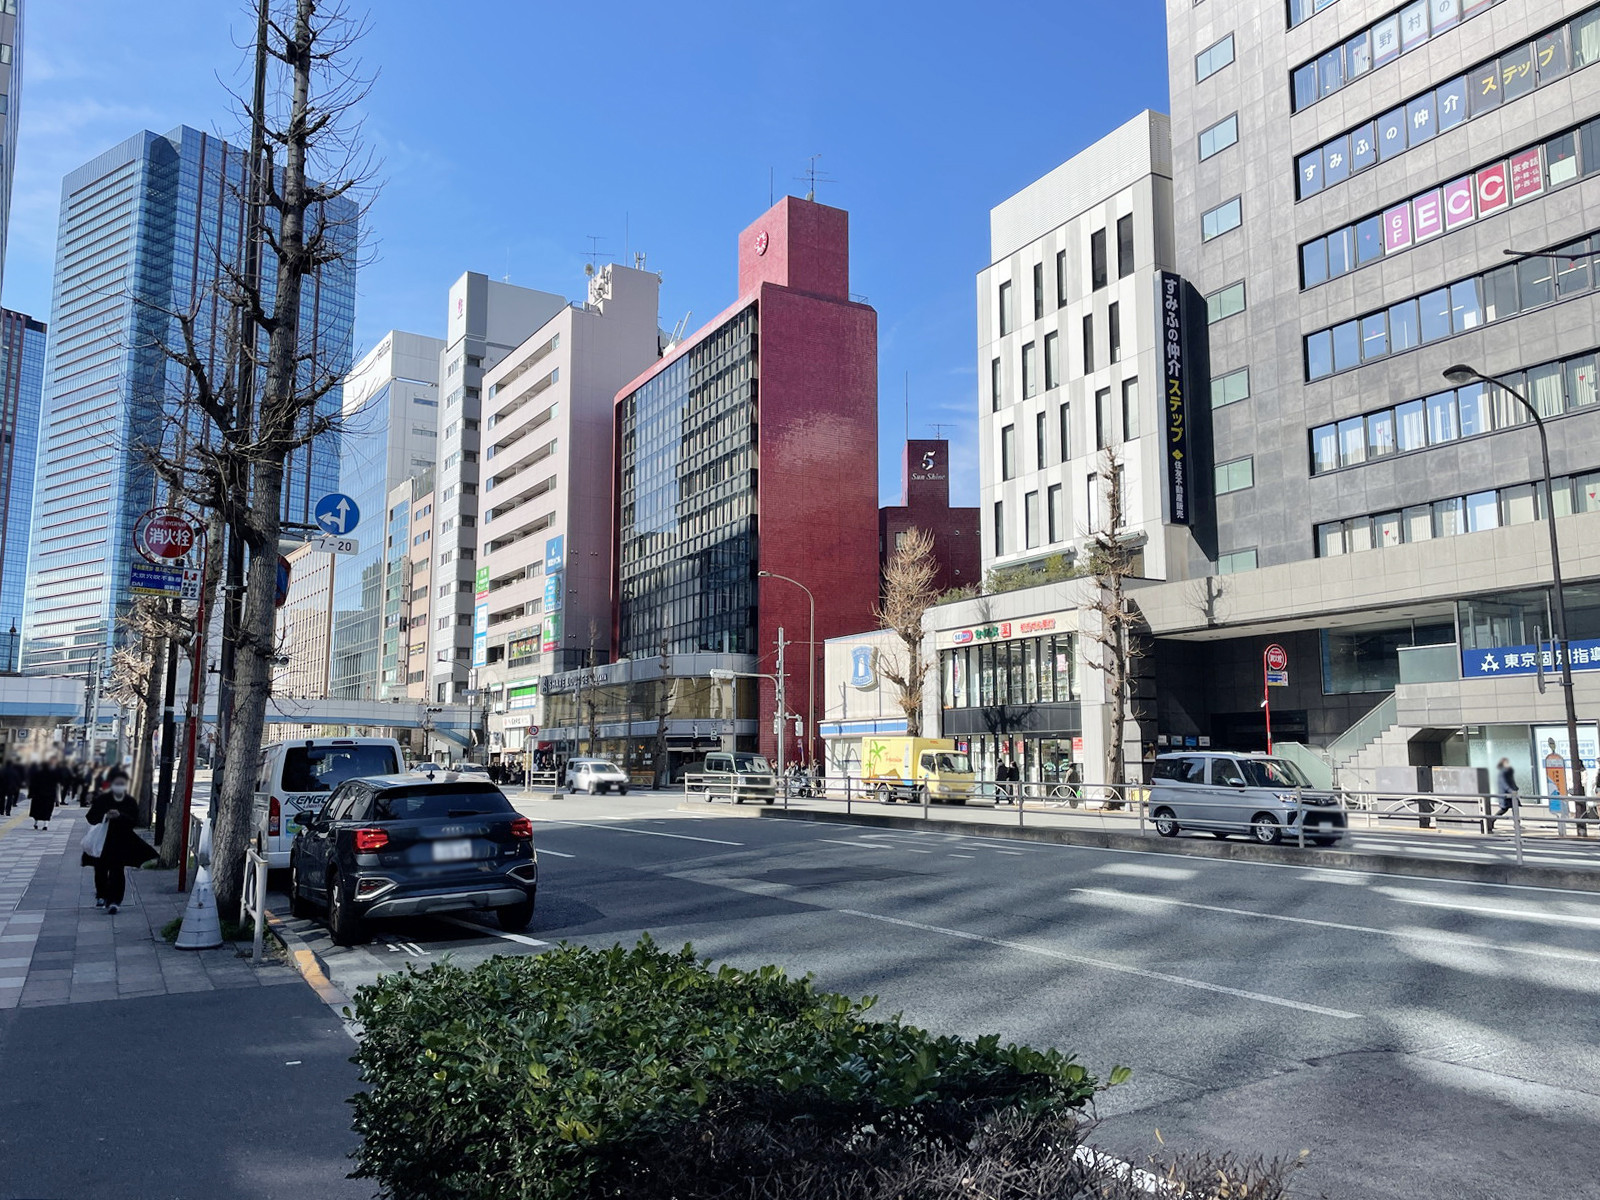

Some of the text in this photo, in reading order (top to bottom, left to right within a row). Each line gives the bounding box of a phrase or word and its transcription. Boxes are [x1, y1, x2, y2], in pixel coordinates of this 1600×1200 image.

[1513, 156, 1539, 175] 英会話
[922, 450, 936, 470] 5
[912, 472, 946, 481] Sun Shine
[1174, 461, 1184, 519] 住友不動産販売
[149, 528, 191, 546] 消火栓
